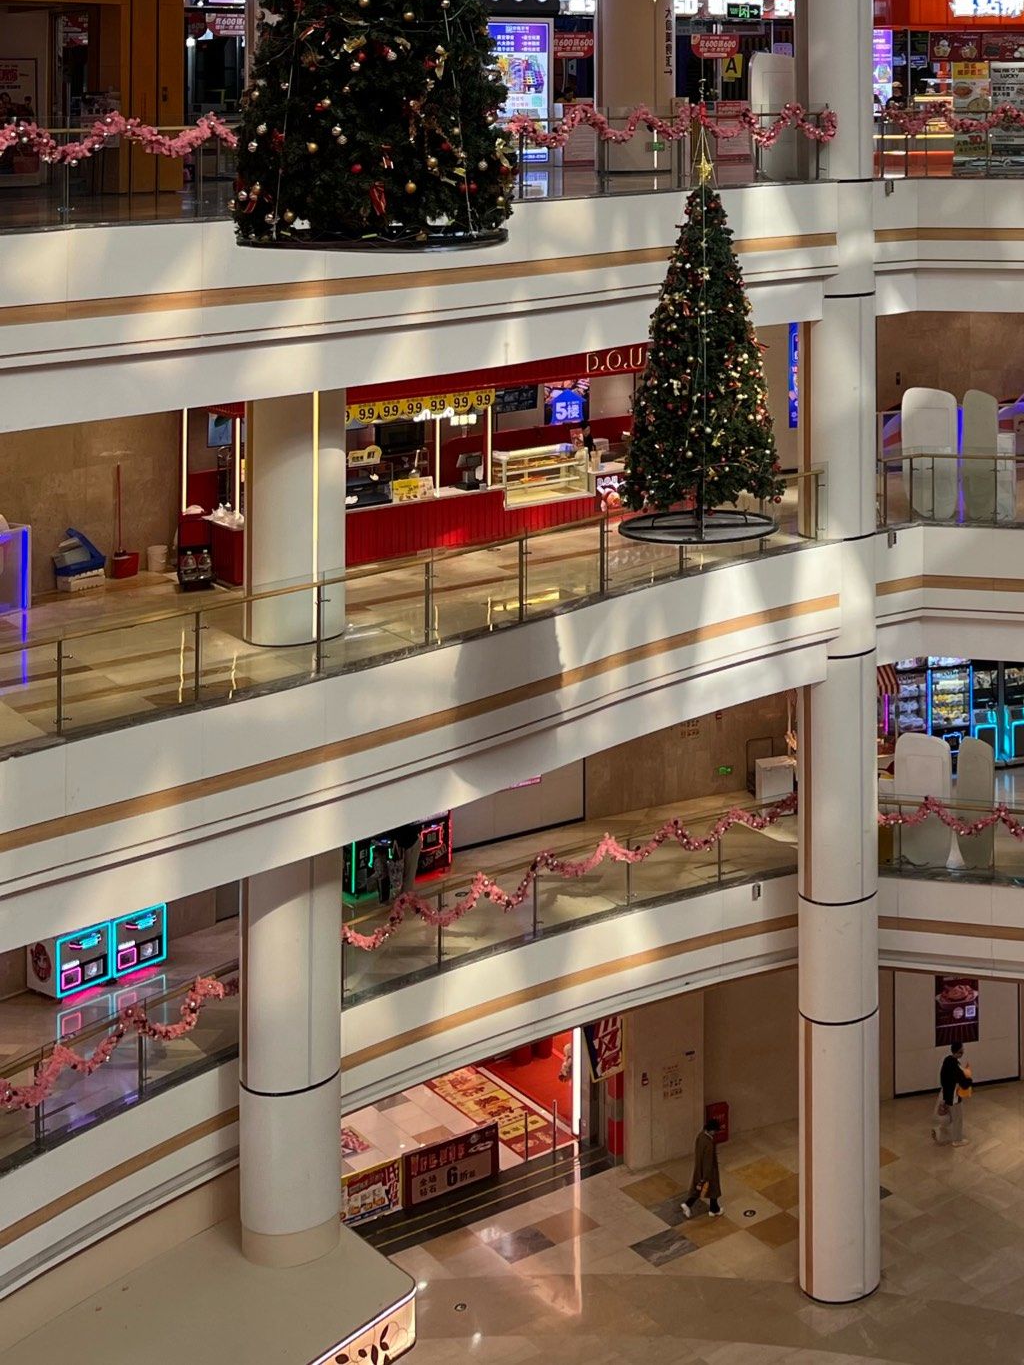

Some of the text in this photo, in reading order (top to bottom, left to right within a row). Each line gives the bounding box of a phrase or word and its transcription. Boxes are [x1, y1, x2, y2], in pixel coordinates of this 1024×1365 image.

[725, 58, 737, 74] A
[431, 399, 446, 411] 9.9
[454, 396, 469, 409] 9.9
[476, 393, 491, 406] 9.9
[359, 407, 375, 420] 9.9
[383, 404, 399, 417] 9.9
[407, 402, 422, 414] 9.9
[555, 400, 580, 420] 5楼
